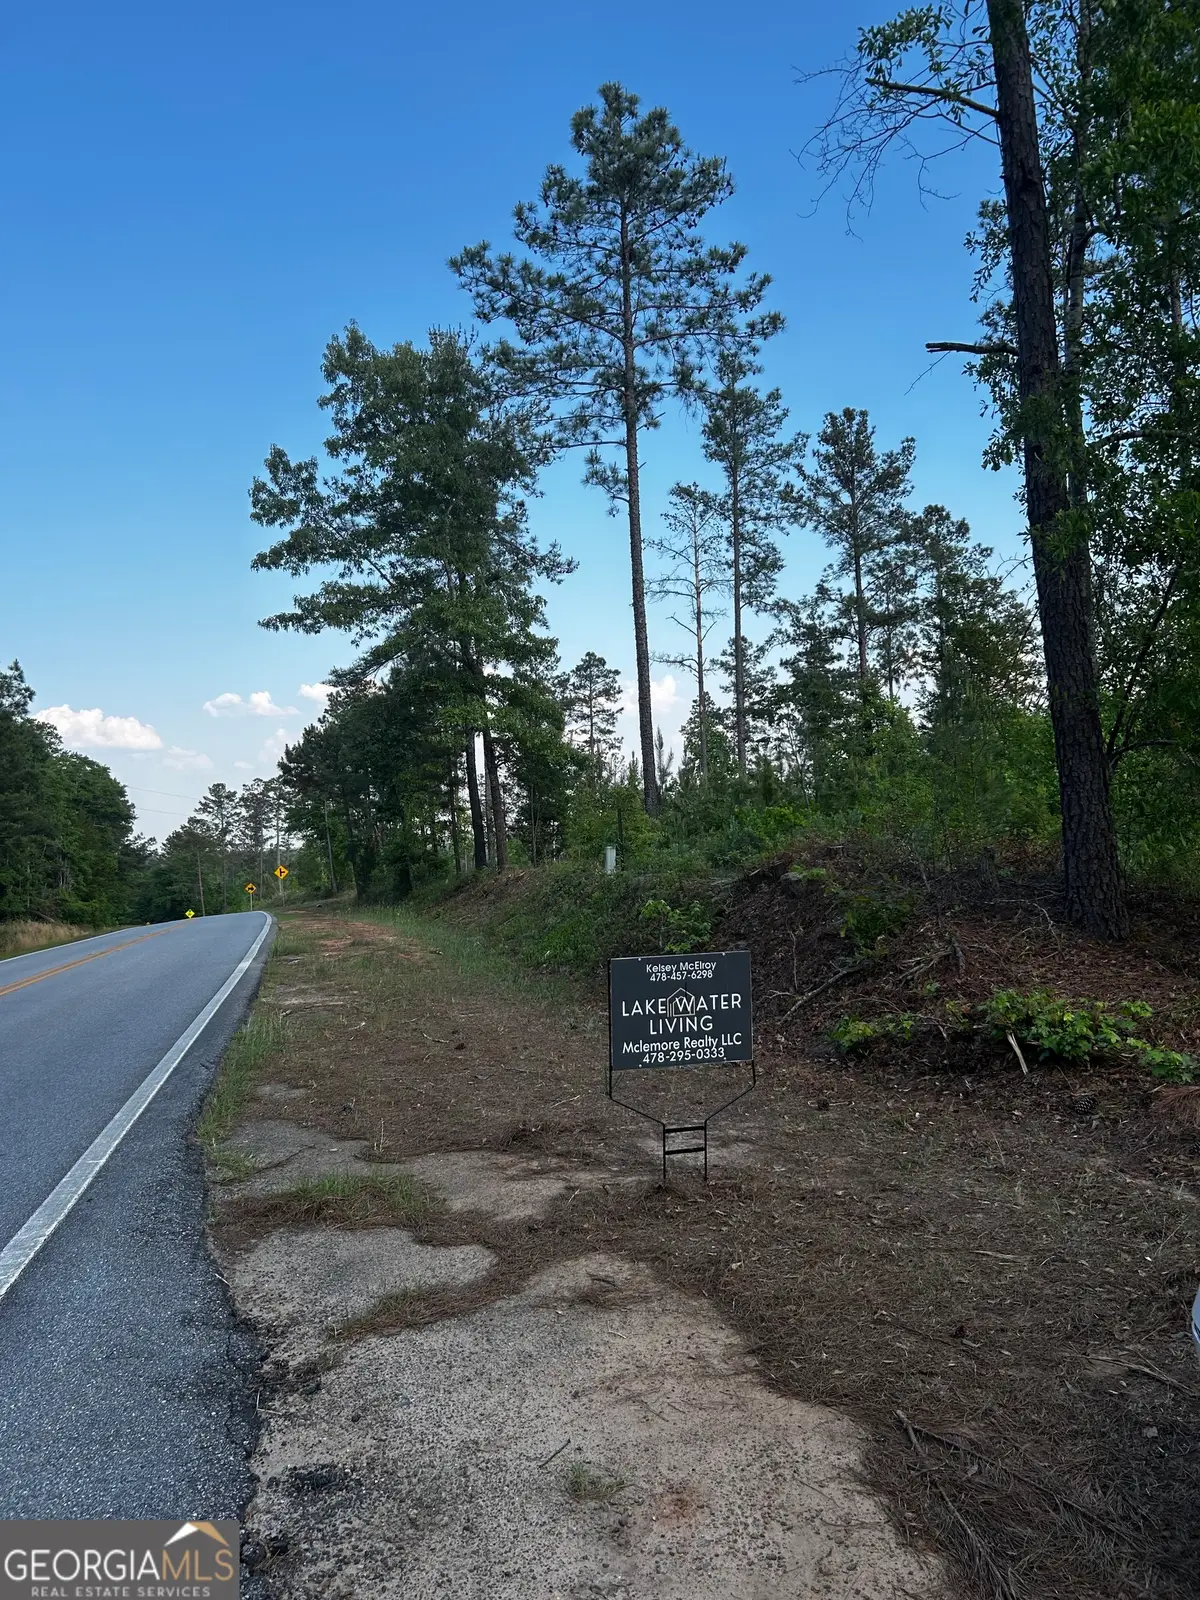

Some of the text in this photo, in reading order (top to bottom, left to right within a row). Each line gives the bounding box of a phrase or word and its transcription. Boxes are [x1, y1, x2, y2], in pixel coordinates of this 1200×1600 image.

[646, 961, 717, 973] Kelsey McElroy
[650, 970, 713, 982] 478-457-6298
[622, 993, 742, 1016] LAKE WATER
[650, 1015, 713, 1035] LIVING
[684, 1035, 719, 1049] Realty
[721, 1033, 742, 1046] LLC
[643, 1047, 725, 1064] 478-295-0333
